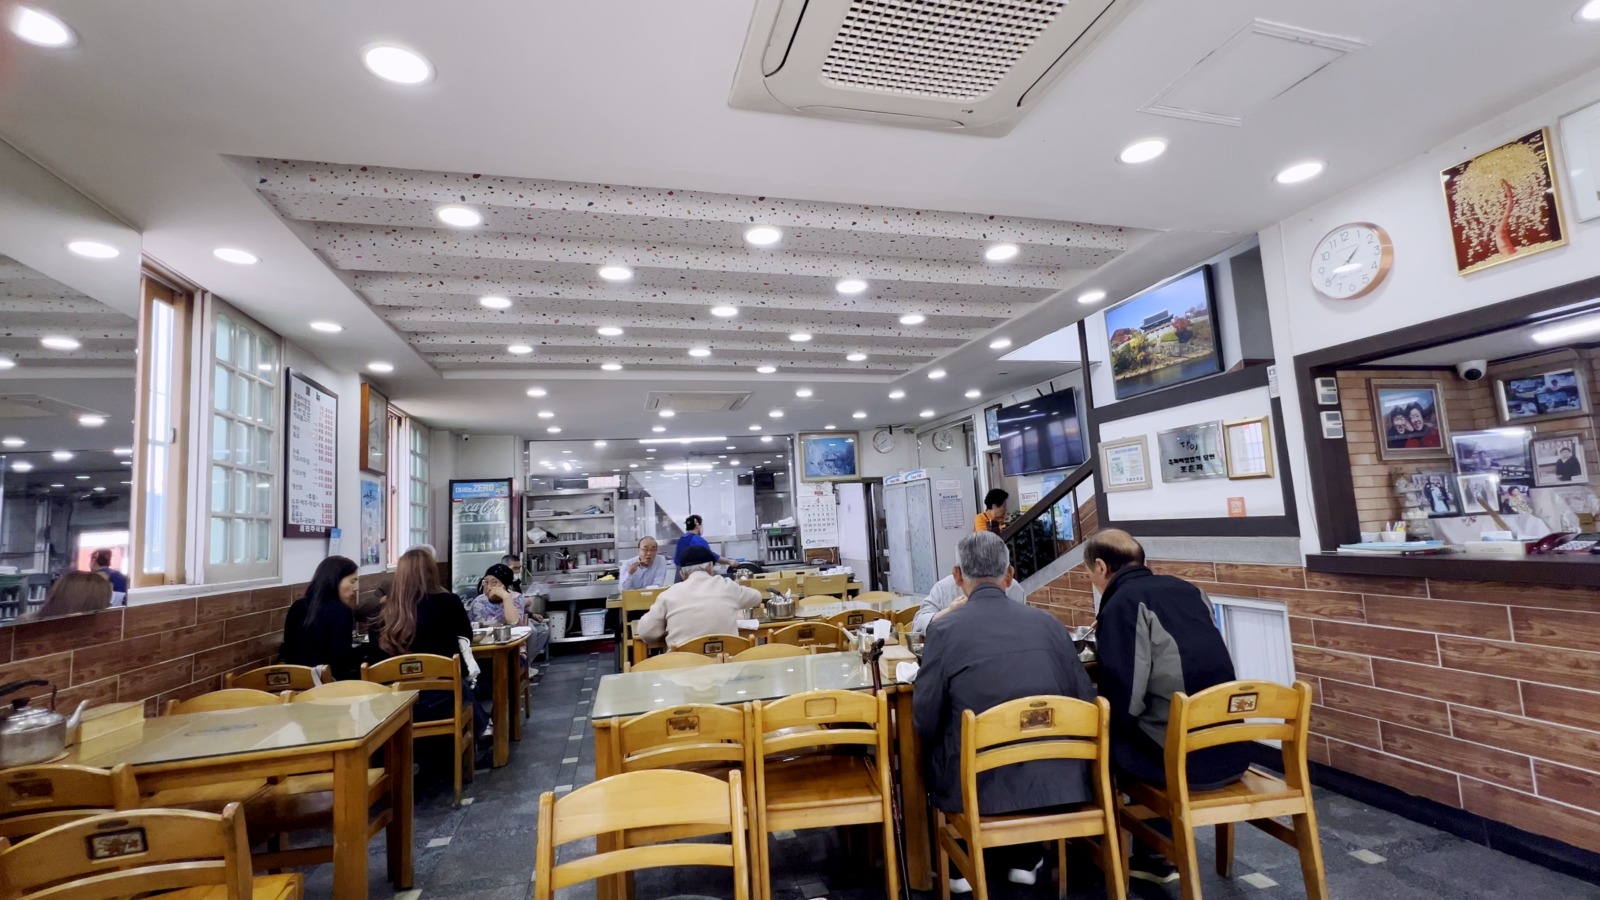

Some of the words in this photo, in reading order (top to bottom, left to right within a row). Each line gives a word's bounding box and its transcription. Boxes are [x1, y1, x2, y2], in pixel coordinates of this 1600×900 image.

[1340, 231, 1349, 241] 12
[1357, 230, 1360, 238] 1
[1366, 234, 1373, 244] 2
[1329, 240, 1337, 249] 11
[1373, 245, 1380, 255] 3
[1321, 251, 1330, 261] 10
[1319, 267, 1325, 275] 9
[1325, 278, 1331, 287] 8
[1362, 274, 1369, 284] 5
[1337, 283, 1342, 292] 7
[1349, 283, 1356, 291] 6
[473, 484, 494, 492] ZERO
